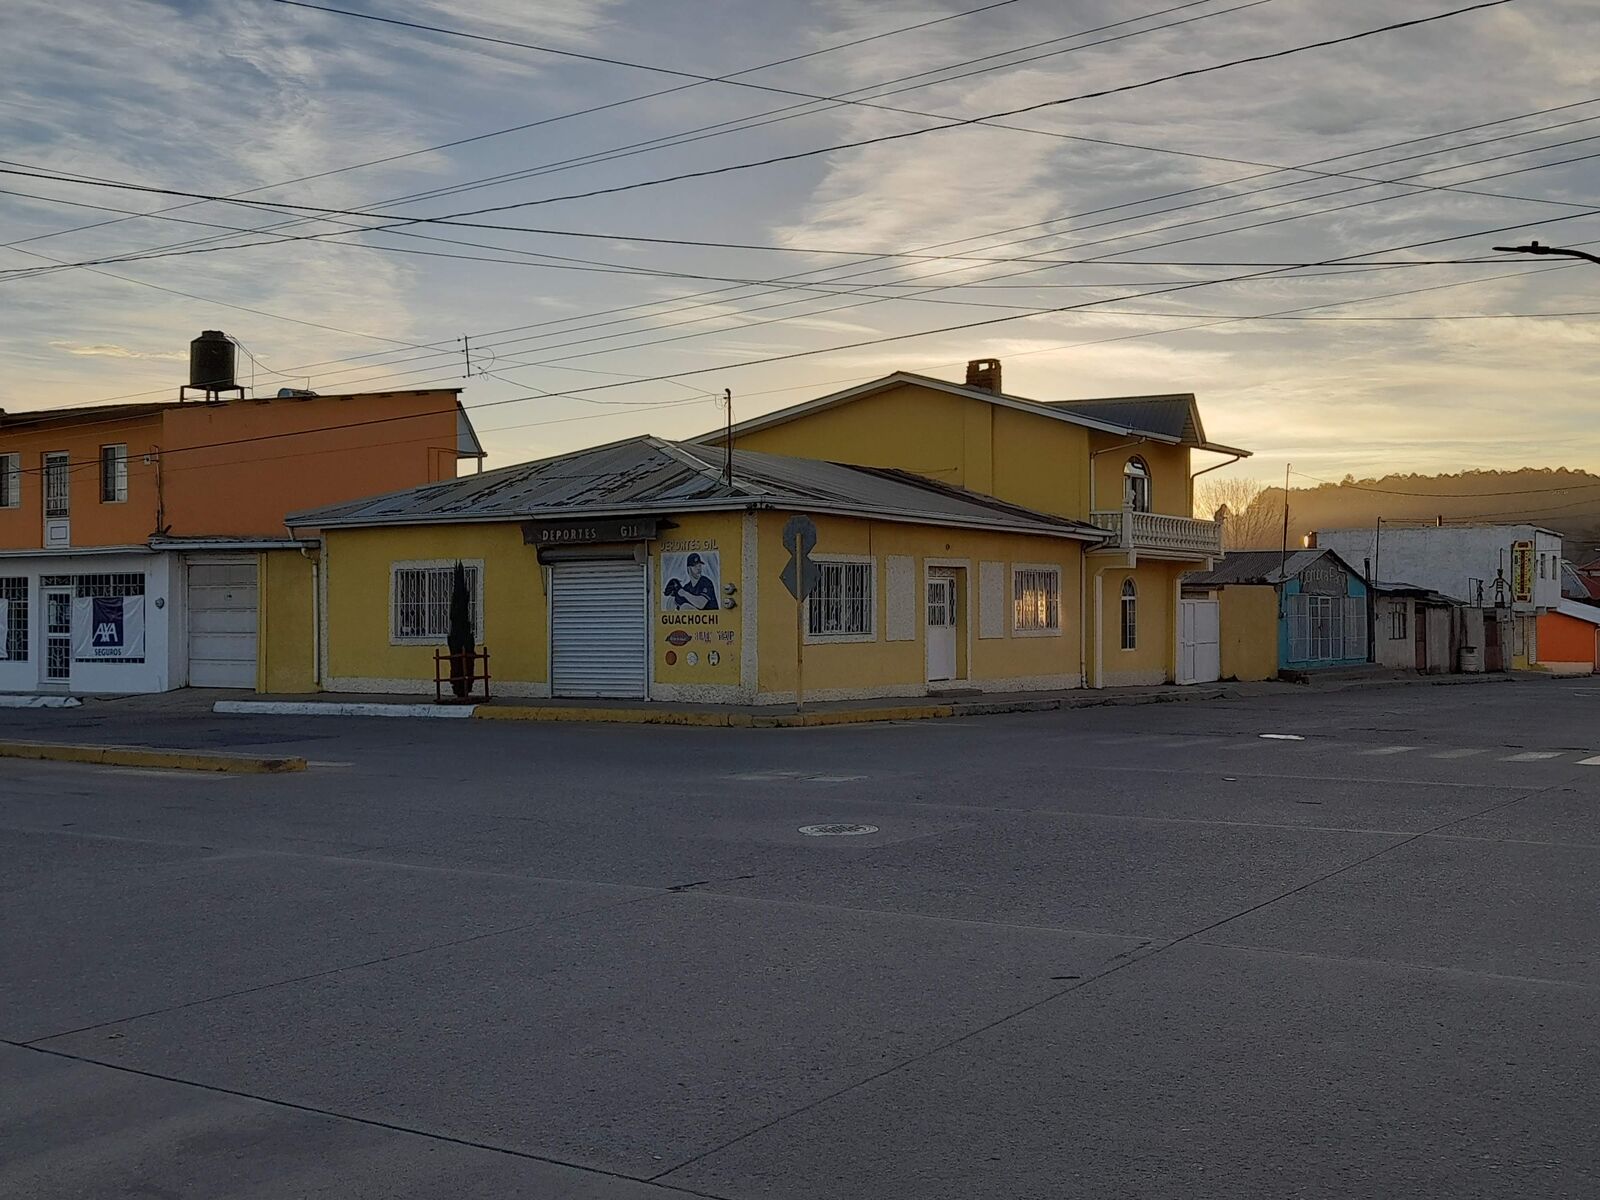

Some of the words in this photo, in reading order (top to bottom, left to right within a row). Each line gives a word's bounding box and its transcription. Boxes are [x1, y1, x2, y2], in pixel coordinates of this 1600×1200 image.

[542, 527, 597, 541] DEPORTES
[660, 539, 701, 552] DEPORTES
[703, 539, 719, 550] GIL
[662, 615, 719, 625] GUACHOCHI
[92, 623, 118, 642] AXA
[94, 648, 122, 656] SEGUROS
